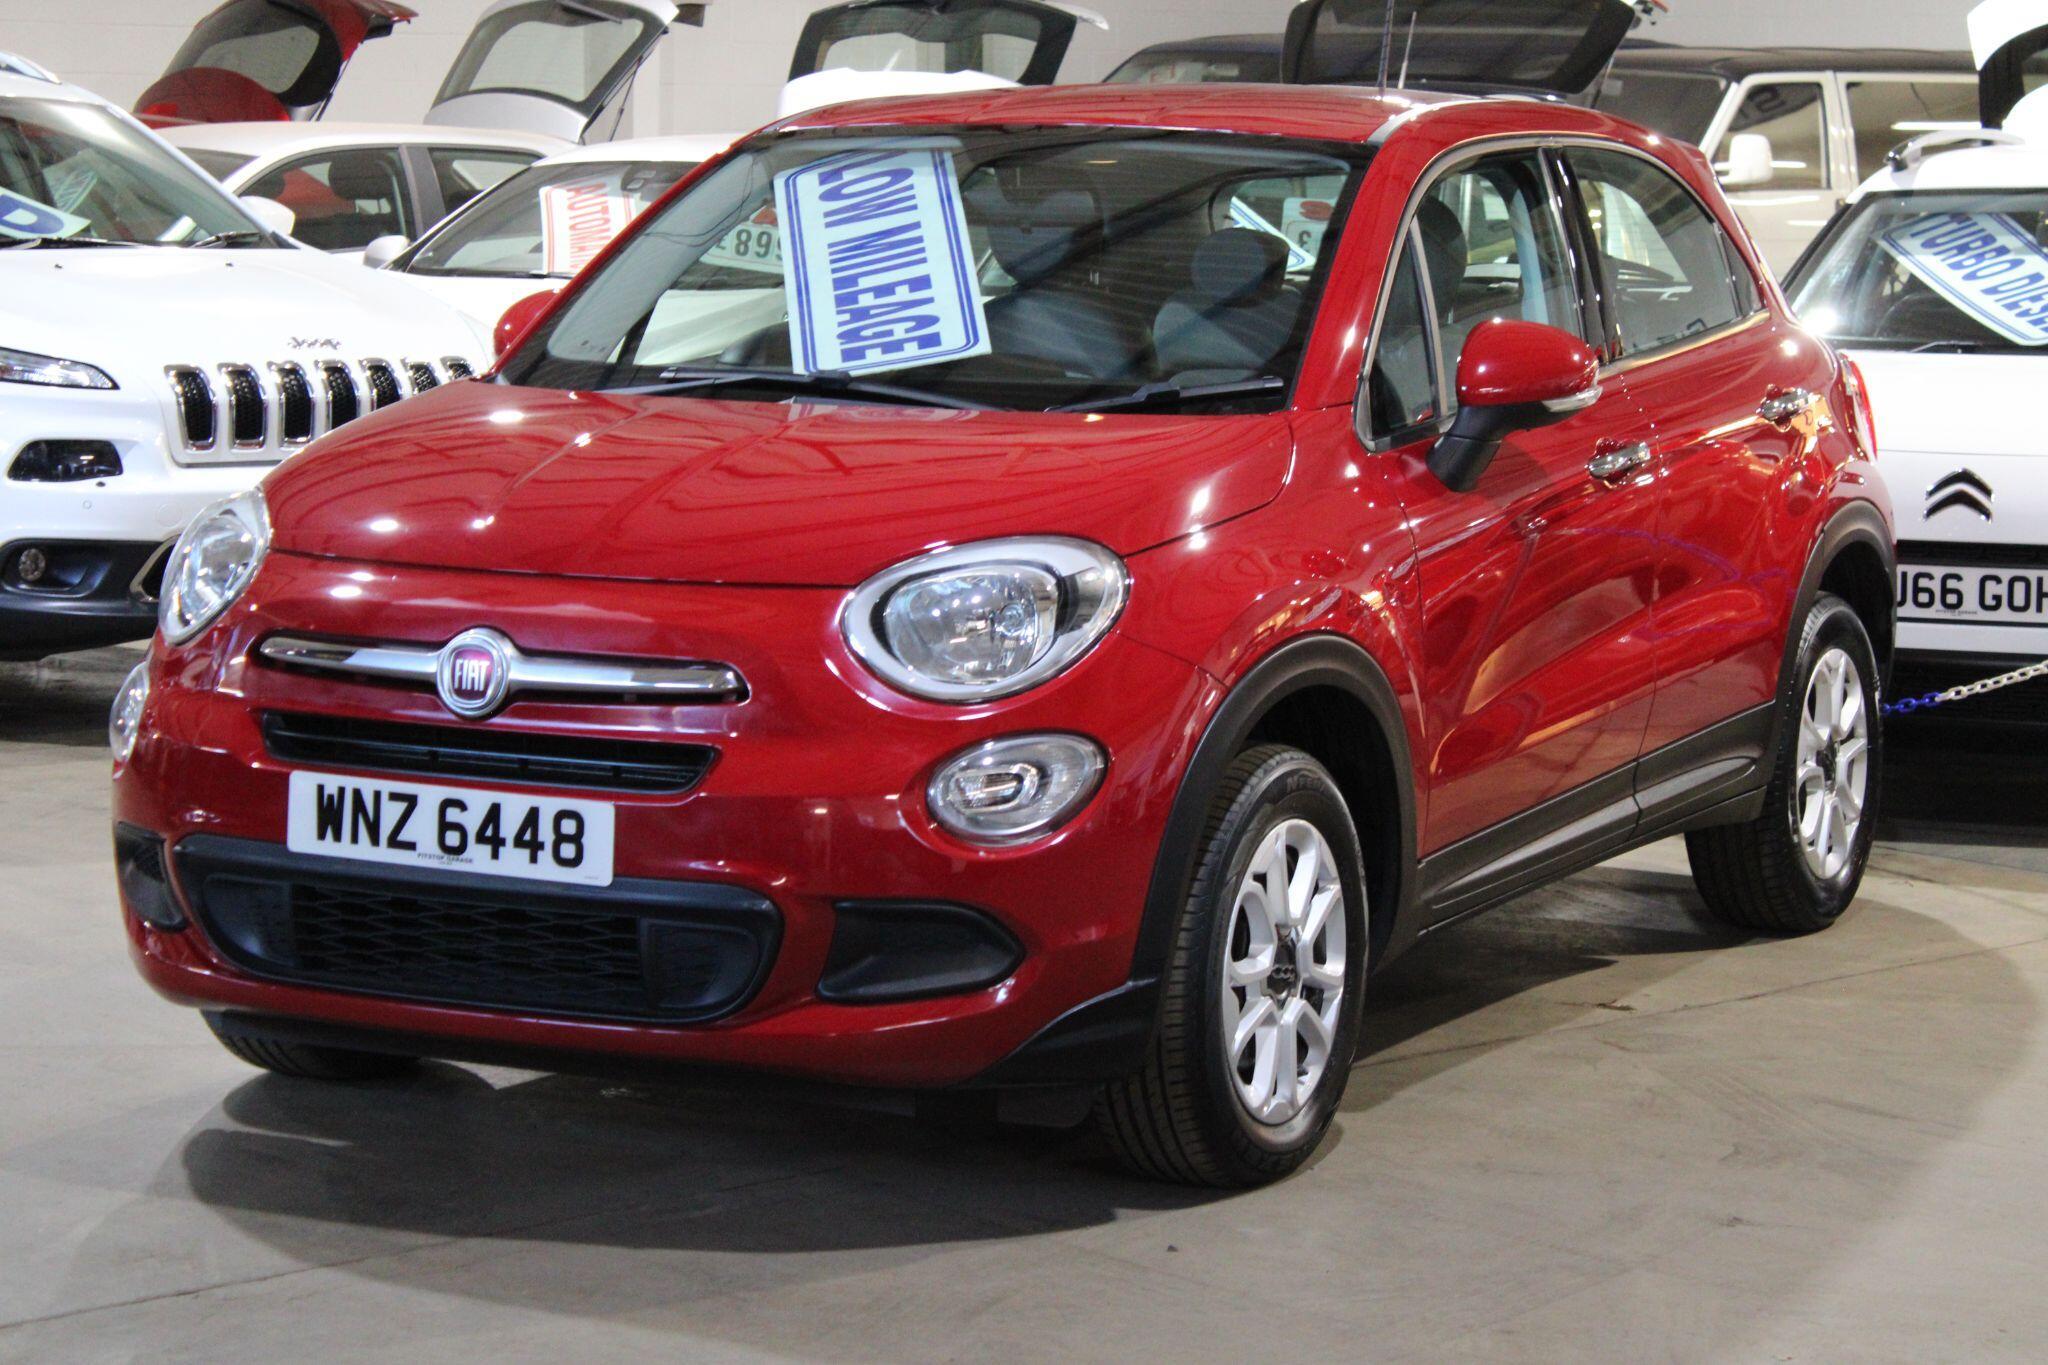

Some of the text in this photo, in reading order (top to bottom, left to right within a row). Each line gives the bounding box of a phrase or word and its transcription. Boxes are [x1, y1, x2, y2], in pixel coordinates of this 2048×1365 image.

[566, 182, 612, 270] AUTOMA
[818, 151, 942, 363] LOW MILEAGE
[1910, 213, 2048, 333] TURBO DIES
[454, 658, 491, 692] FIAT
[317, 784, 585, 868] WNZ 6448
